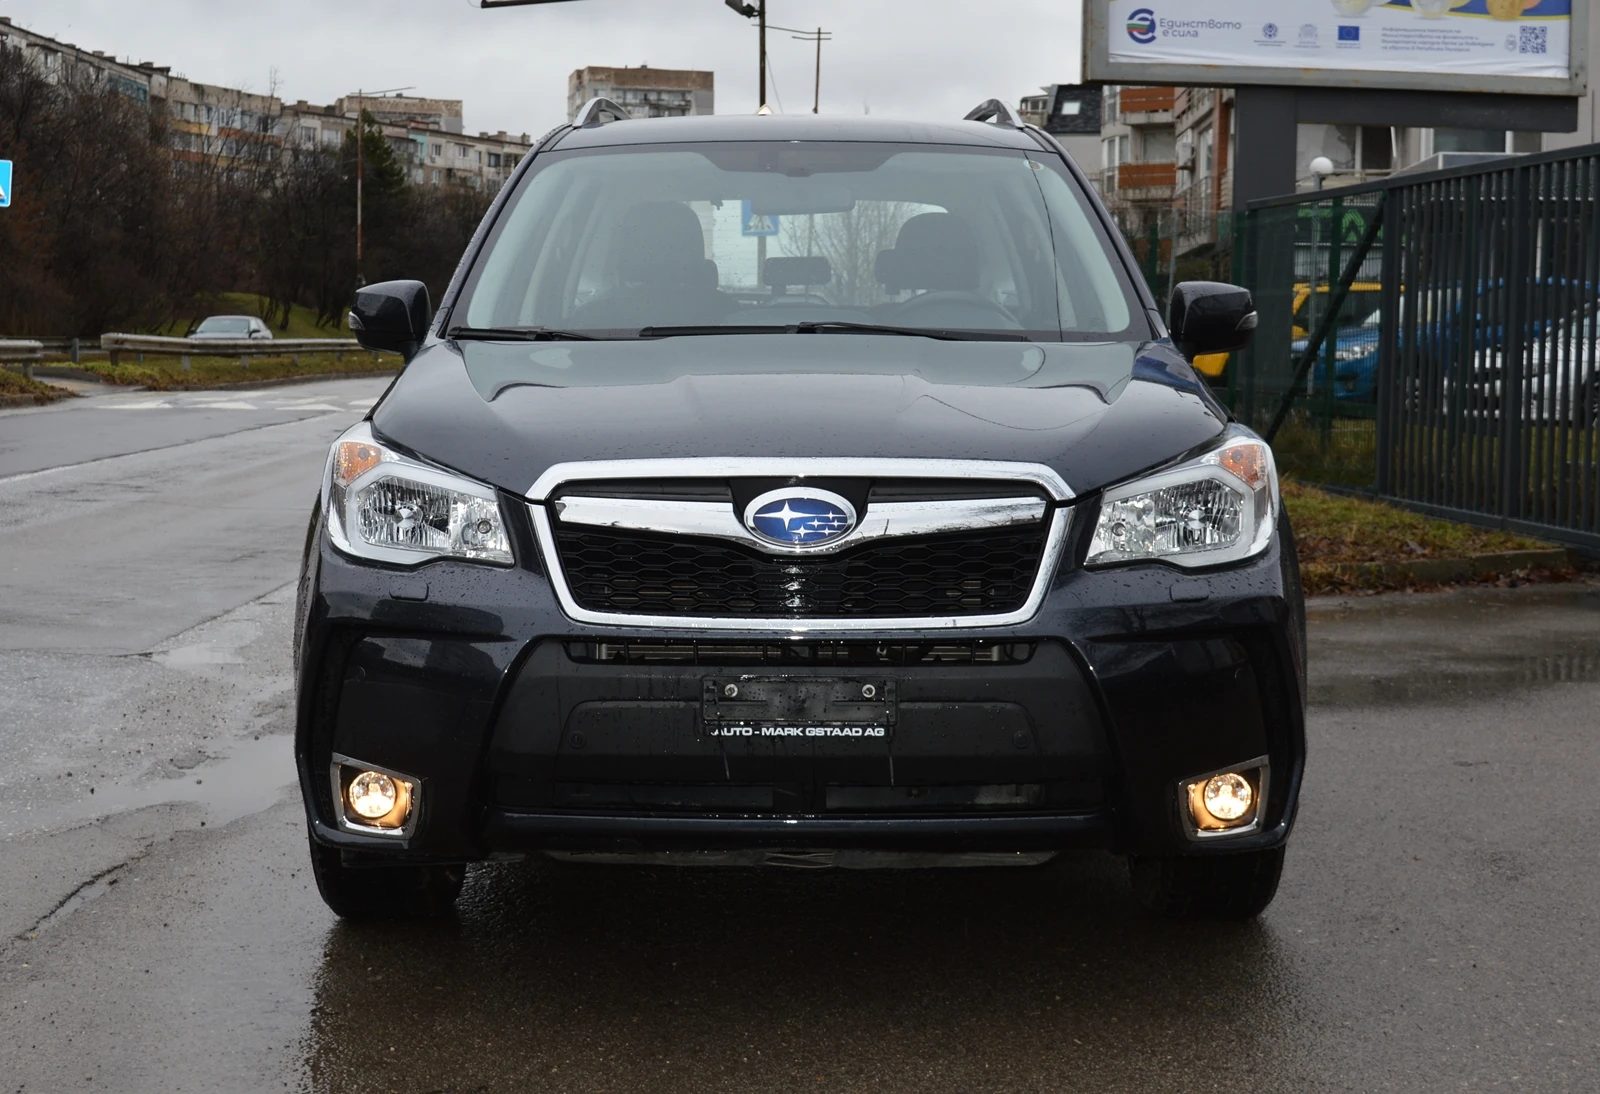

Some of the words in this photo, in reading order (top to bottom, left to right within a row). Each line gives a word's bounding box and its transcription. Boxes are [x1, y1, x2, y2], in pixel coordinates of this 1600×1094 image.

[1159, 18, 1242, 30] Единството
[1172, 30, 1199, 38] сила
[710, 727, 753, 736] AUTO
[761, 727, 803, 736] MARK
[805, 727, 863, 736] GSTAAD
[863, 727, 885, 736] AG
